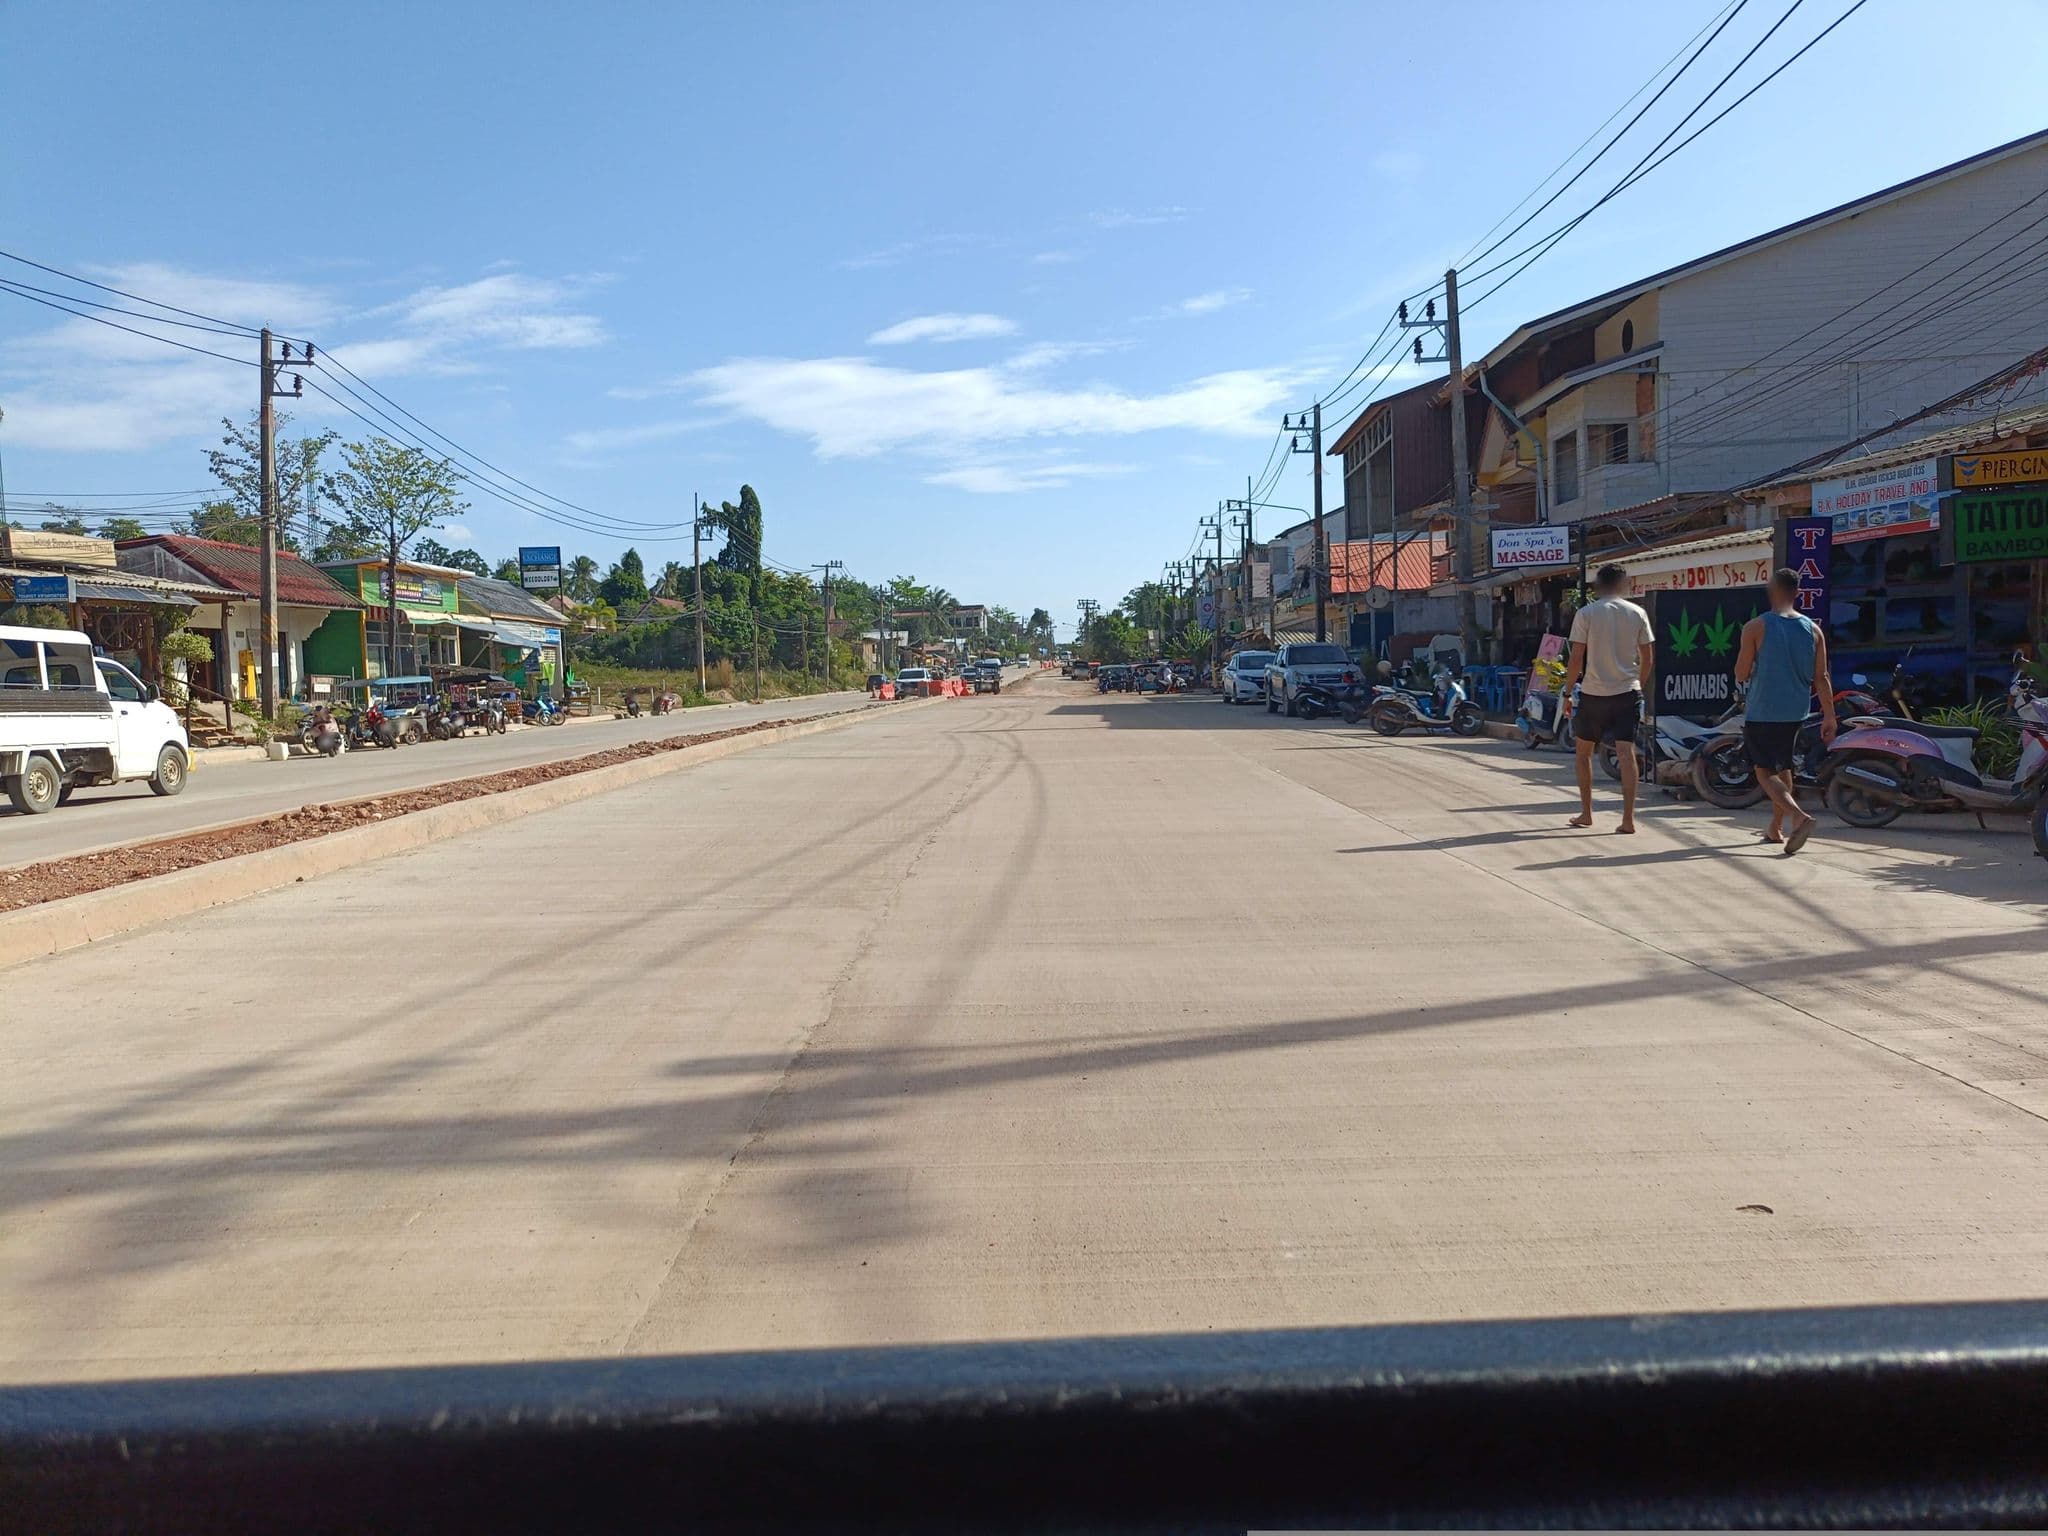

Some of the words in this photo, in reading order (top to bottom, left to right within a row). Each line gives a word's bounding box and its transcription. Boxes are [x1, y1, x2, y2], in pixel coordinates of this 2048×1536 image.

[1836, 490, 1872, 510] HOLIDAY
[1874, 484, 1907, 503] TRAVEL
[1910, 480, 1929, 496] AND
[1963, 497, 2048, 533] TATTO
[1497, 548, 1565, 564] MASSAGE
[1498, 538, 1520, 549] Don
[1524, 537, 1544, 549] Spa
[1966, 537, 2048, 557] BAMBO
[1723, 563, 1747, 587] Spa
[1754, 560, 1769, 582] Ya
[1664, 673, 1729, 701] CANNABIS
